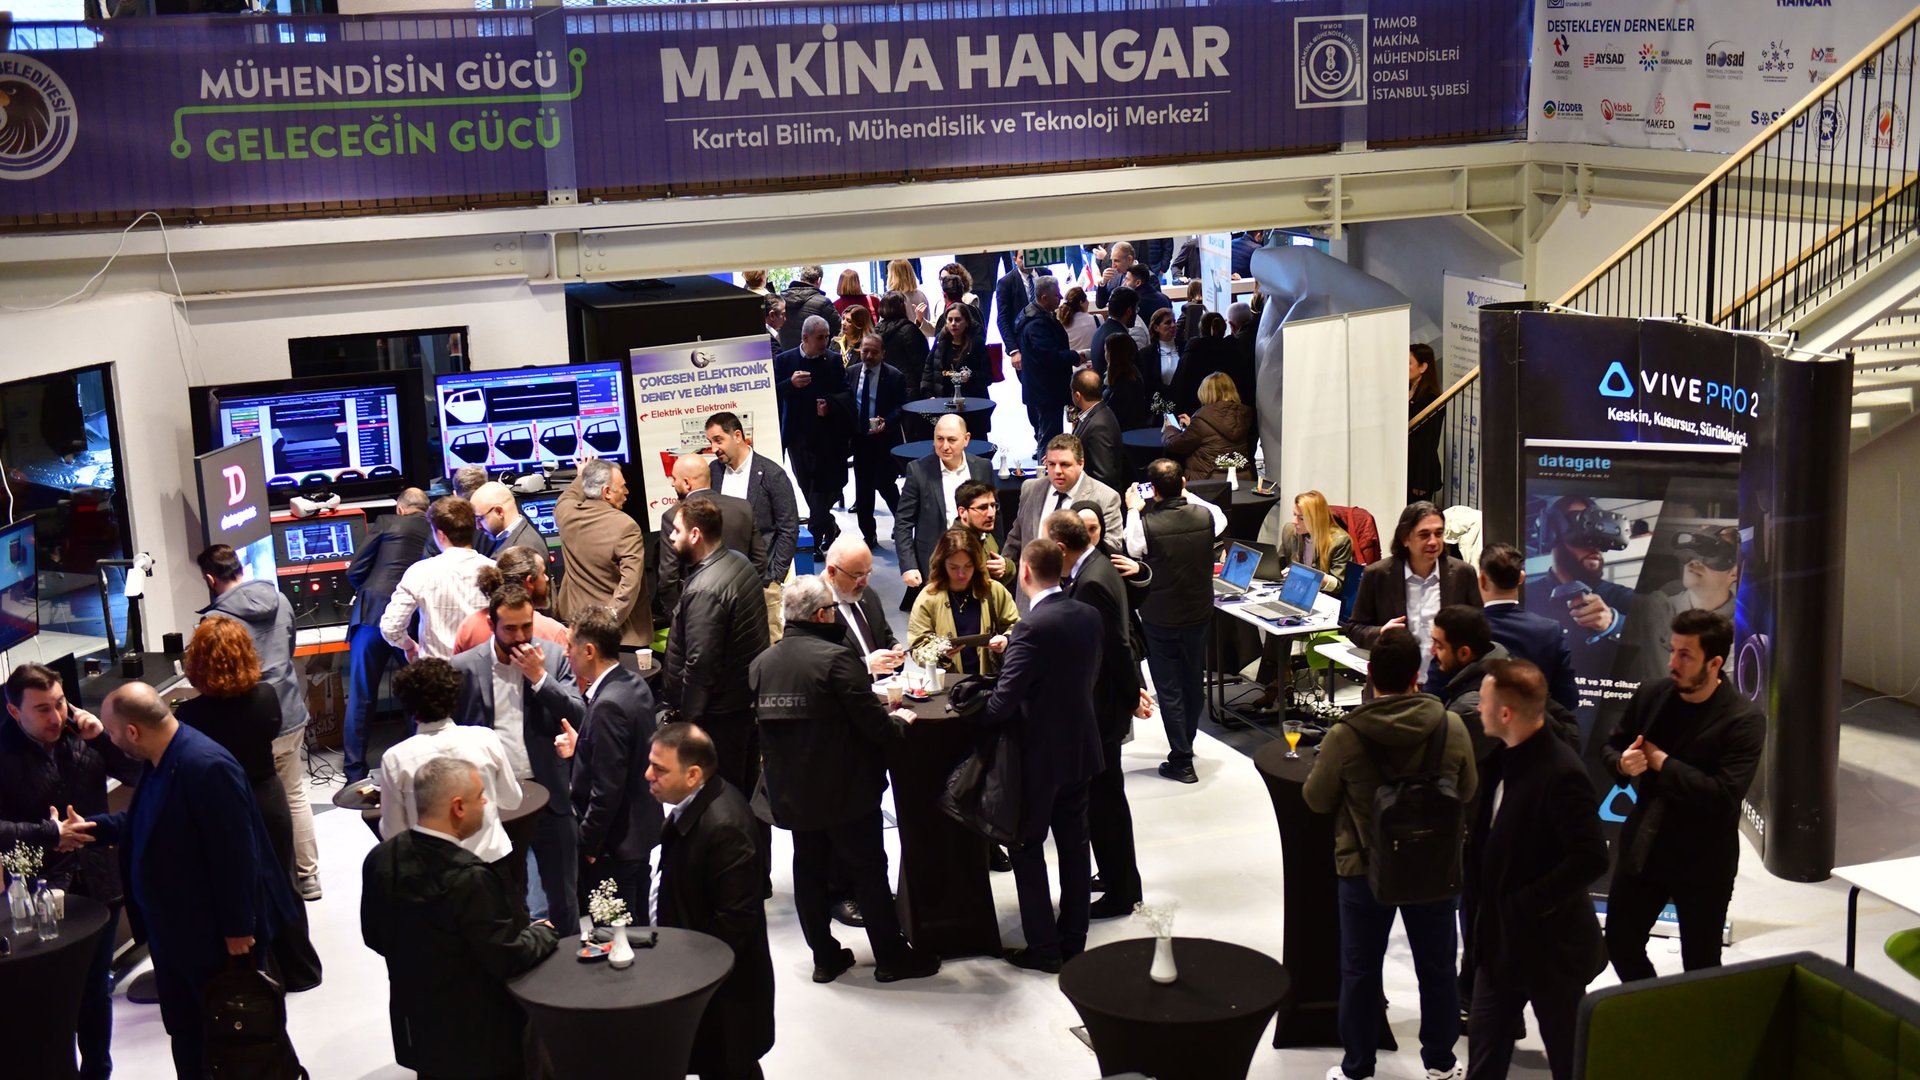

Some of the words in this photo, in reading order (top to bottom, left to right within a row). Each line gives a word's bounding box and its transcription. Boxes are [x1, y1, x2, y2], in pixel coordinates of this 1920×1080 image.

[1373, 16, 1417, 29] TMMOB
[1547, 19, 1621, 33] DESTEKLEYEN
[1624, 18, 1695, 32] DERNEKLER
[1373, 31, 1420, 47] MAKİNA
[660, 23, 944, 104] MAKİNA
[957, 25, 1231, 90] HANGAR
[1373, 45, 1460, 65] MÜHENDİSLERİ
[1595, 53, 1624, 64] AYSAD
[200, 53, 445, 99] MÜHENDİSİN
[455, 50, 557, 91] GÜCÜ
[1373, 69, 1408, 82] ODASI
[1372, 85, 1428, 100] İSTANBUL
[1430, 80, 1469, 100] ŞUBESİ
[1557, 100, 1583, 112] İZODER
[1613, 102, 1632, 112] kbsb
[692, 124, 768, 150] Kartal
[776, 122, 842, 146] Bilim,
[848, 114, 985, 142] Mühendislik
[991, 117, 1016, 134] ve
[1021, 106, 1119, 133] Teknoloji
[1125, 101, 1209, 127] Merkezi
[1645, 119, 1675, 129] MAKFED
[205, 112, 436, 162] GELECEĞİN
[448, 107, 561, 152] GÜCÜ
[1025, 247, 1063, 266] EXIT
[639, 372, 695, 390] ÇOKESEN
[697, 362, 768, 381] ELEKTRONİK
[641, 390, 676, 404] DENEY
[678, 388, 692, 399] VE
[694, 383, 728, 397] EĞİTİM
[730, 377, 771, 392] SETLERİ
[1640, 370, 1702, 403] VIVE
[1706, 381, 1747, 413] PRO
[1750, 391, 1759, 418] 2
[651, 407, 682, 419] Elektrik
[684, 406, 694, 415] ve
[696, 401, 737, 414] Elektronik
[1607, 406, 1652, 426] Keskin,
[1653, 411, 1699, 436] Kusursuz,
[1700, 421, 1748, 447] Sürükleyici.
[1538, 454, 1611, 472] datagate
[222, 465, 247, 506] D
[661, 497, 678, 505] Oto
[1600, 679, 1613, 687] XR
[1614, 680, 1641, 689] cihaz
[758, 696, 807, 707] LACOSTE
